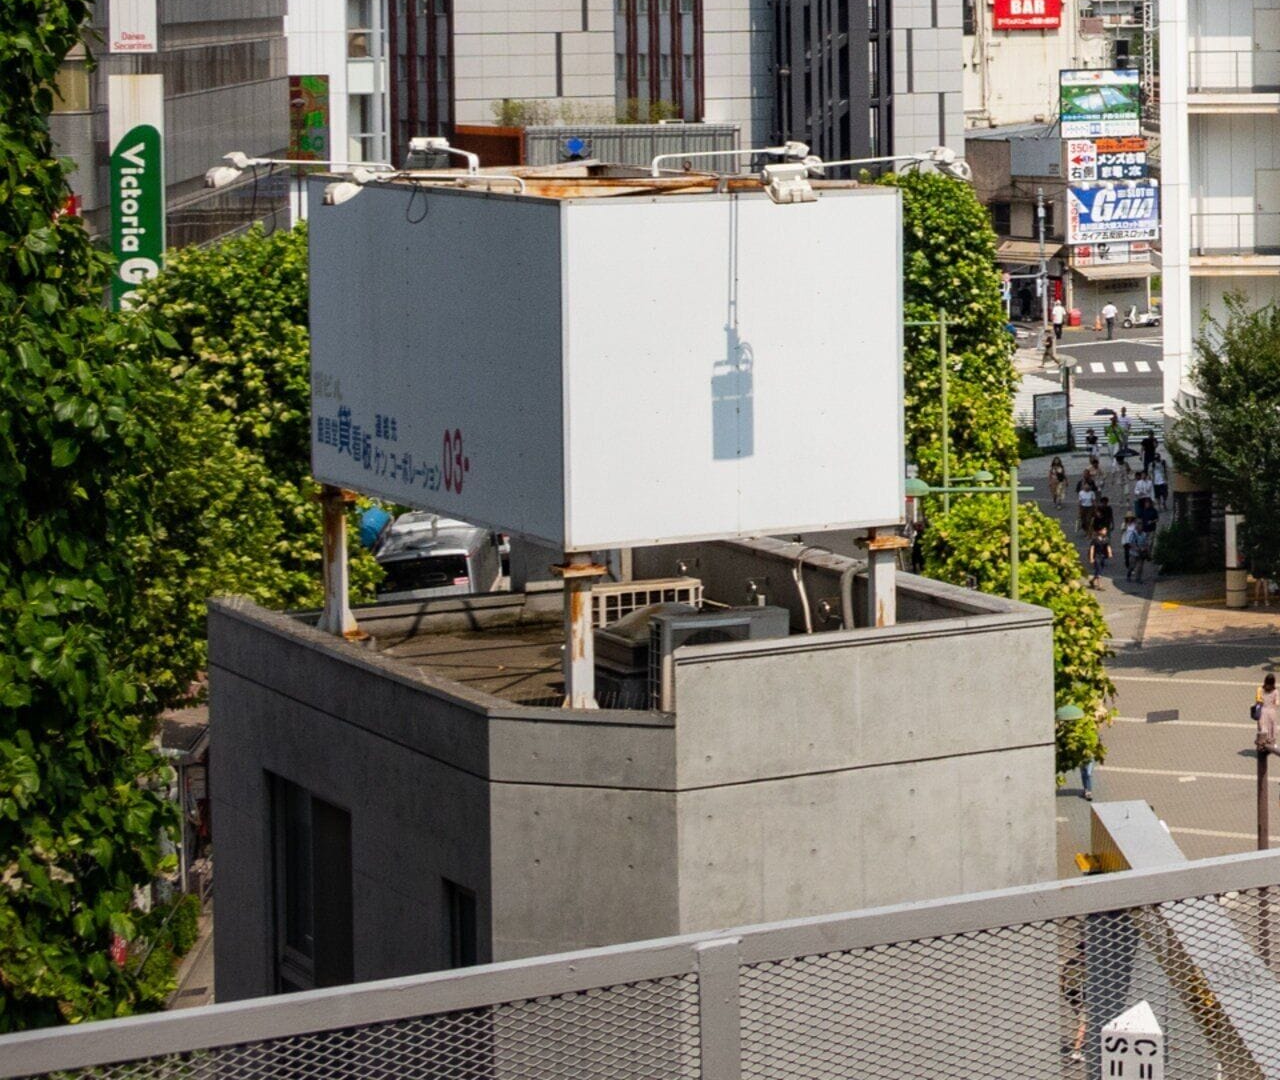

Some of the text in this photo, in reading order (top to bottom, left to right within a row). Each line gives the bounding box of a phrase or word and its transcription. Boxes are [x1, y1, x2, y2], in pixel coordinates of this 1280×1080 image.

[1010, 0, 1046, 15] BAR
[120, 142, 146, 252] Victoria
[1091, 190, 1155, 223] GAIA
